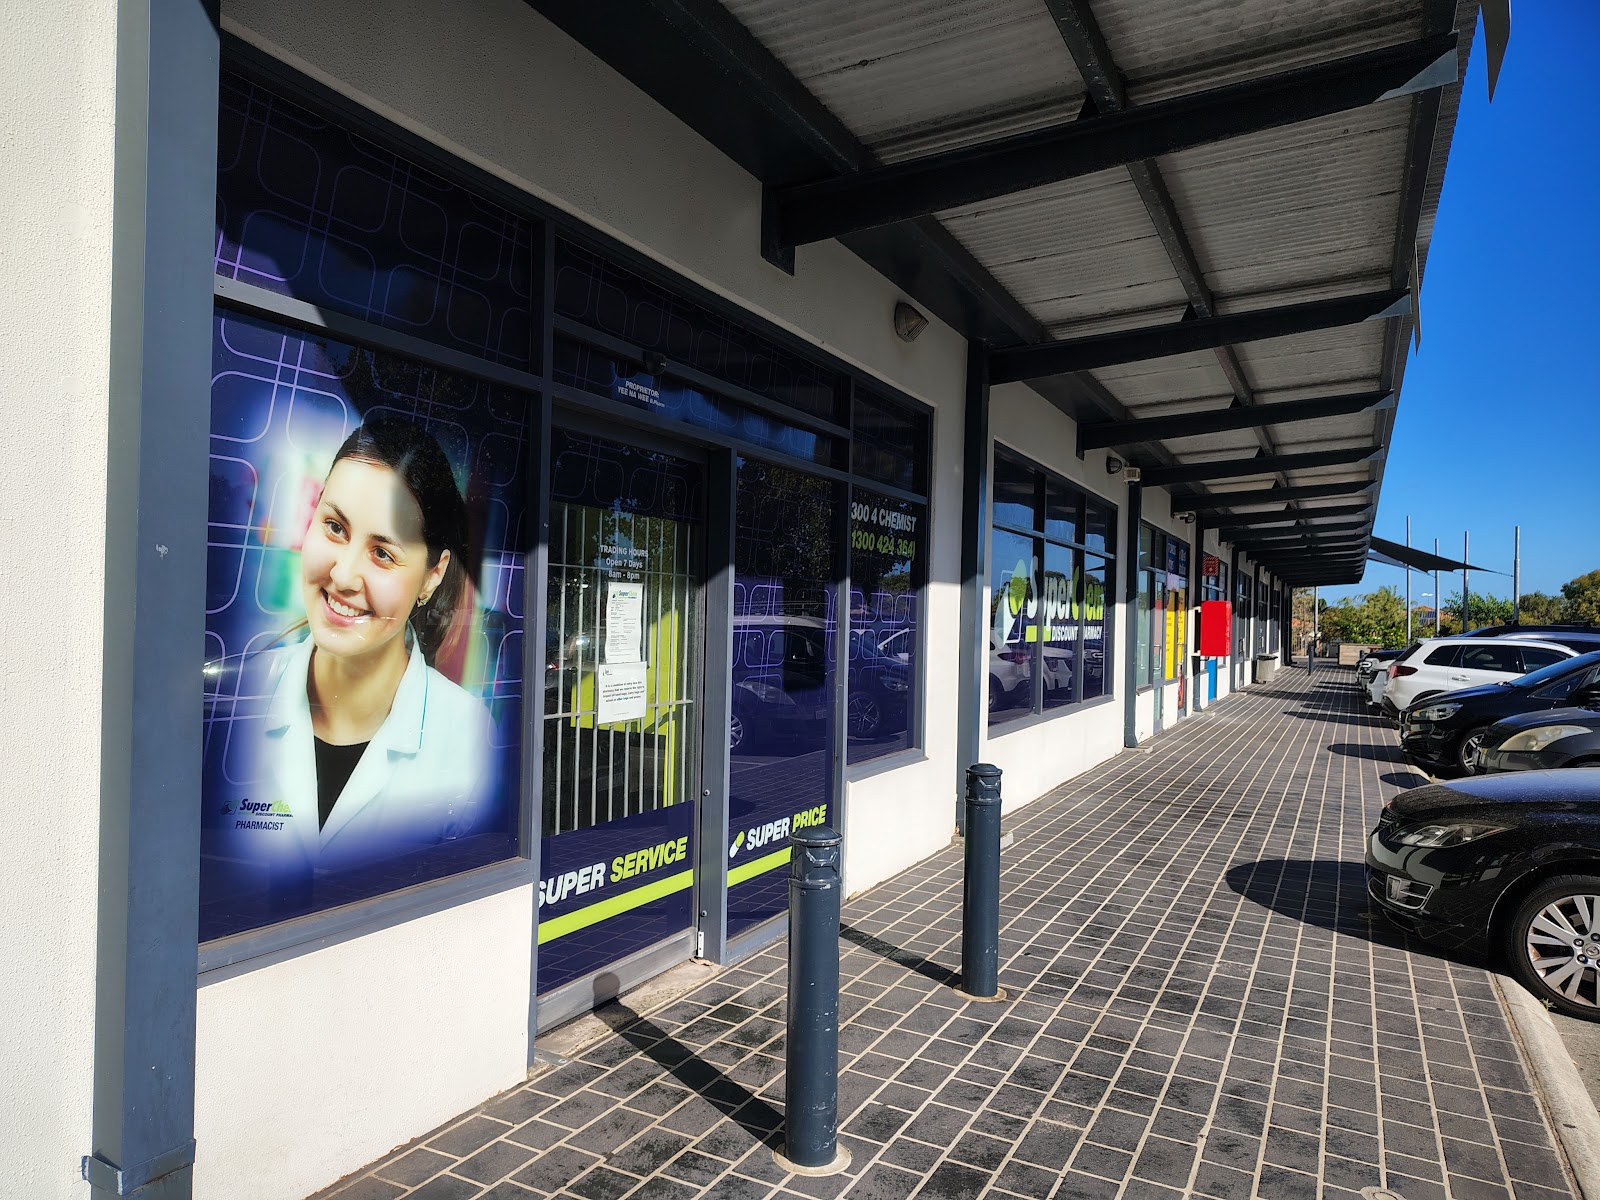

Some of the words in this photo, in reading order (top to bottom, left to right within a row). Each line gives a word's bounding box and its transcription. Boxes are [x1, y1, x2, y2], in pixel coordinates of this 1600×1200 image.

[617, 385, 628, 396] YEE
[629, 389, 637, 399] NA
[637, 393, 649, 403] WEE
[625, 380, 660, 398] PROPRIETOR:
[851, 502, 869, 522] 300
[871, 507, 877, 524] 4
[879, 508, 916, 532] CHEMIST
[600, 545, 627, 555] TRADING
[629, 548, 648, 557] HOURS
[877, 535, 894, 554] 424
[606, 557, 622, 567] Open
[629, 560, 643, 570] Days
[609, 570, 621, 578] 8am
[627, 572, 640, 580] 8pm
[1052, 625, 1079, 641] DISCOUNT
[240, 798, 292, 813] SuperChe
[235, 820, 284, 831] PHARMACIST
[747, 817, 790, 851] SUPER
[792, 804, 828, 834] PRICE
[538, 862, 606, 908] SUPER
[609, 836, 688, 883] SERVICE
